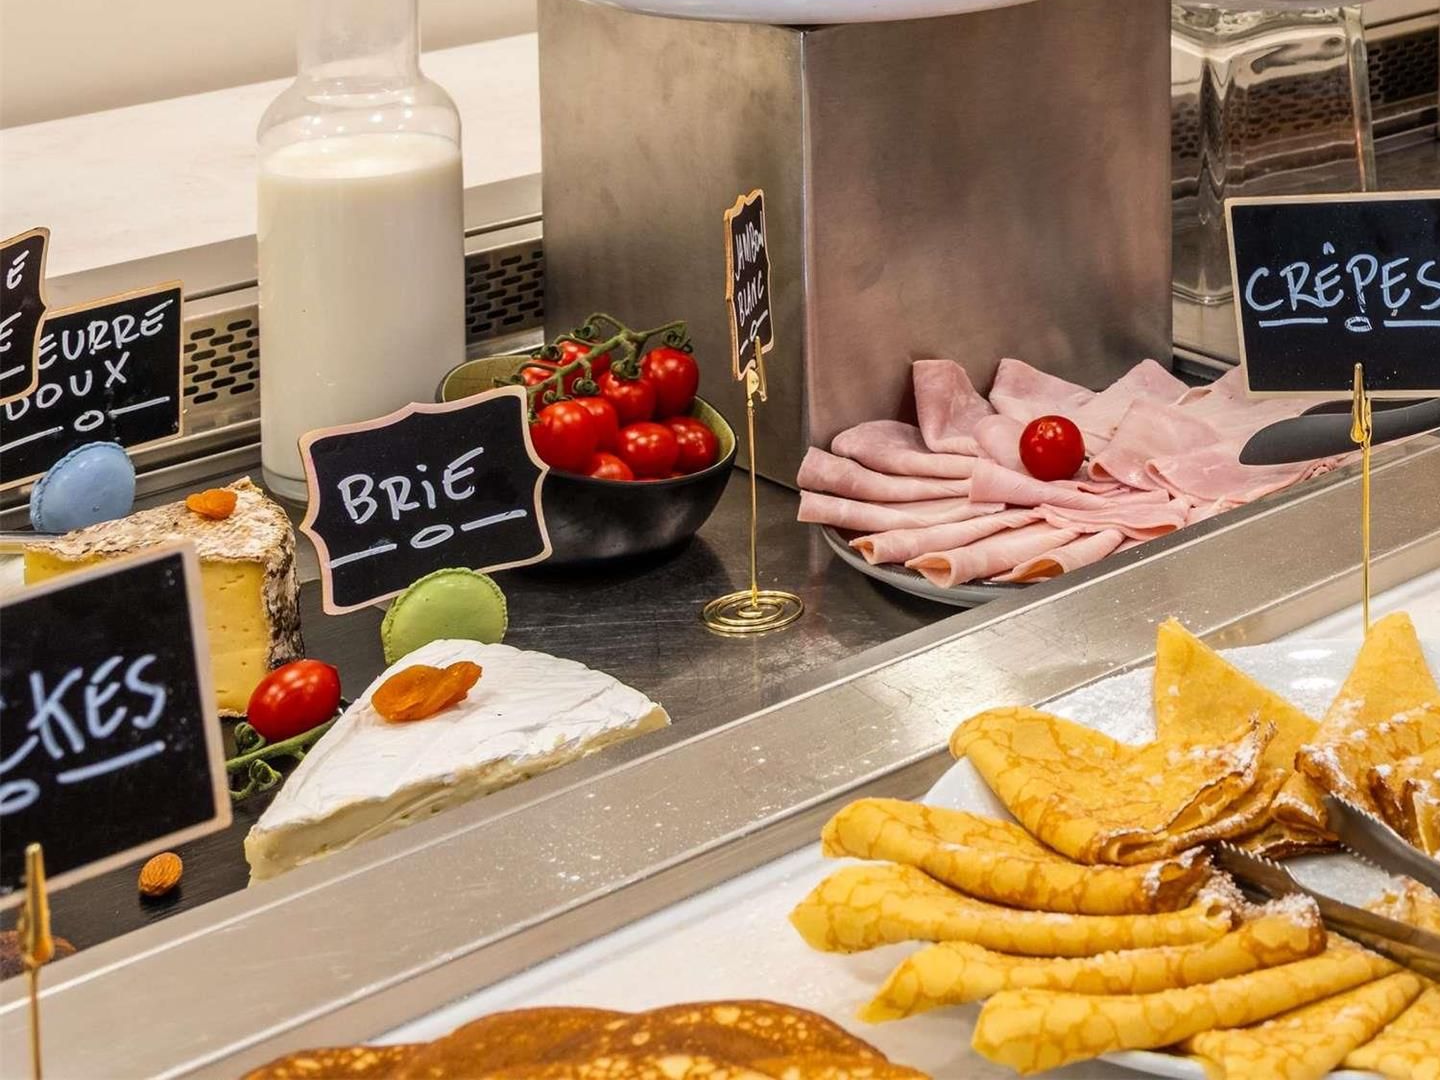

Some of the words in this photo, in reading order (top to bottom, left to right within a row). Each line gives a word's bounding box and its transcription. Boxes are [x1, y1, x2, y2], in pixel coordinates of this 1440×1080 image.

[737, 270, 765, 327] BLANC
[37, 299, 174, 370] EURRE
[5, 351, 131, 421] DOUX
